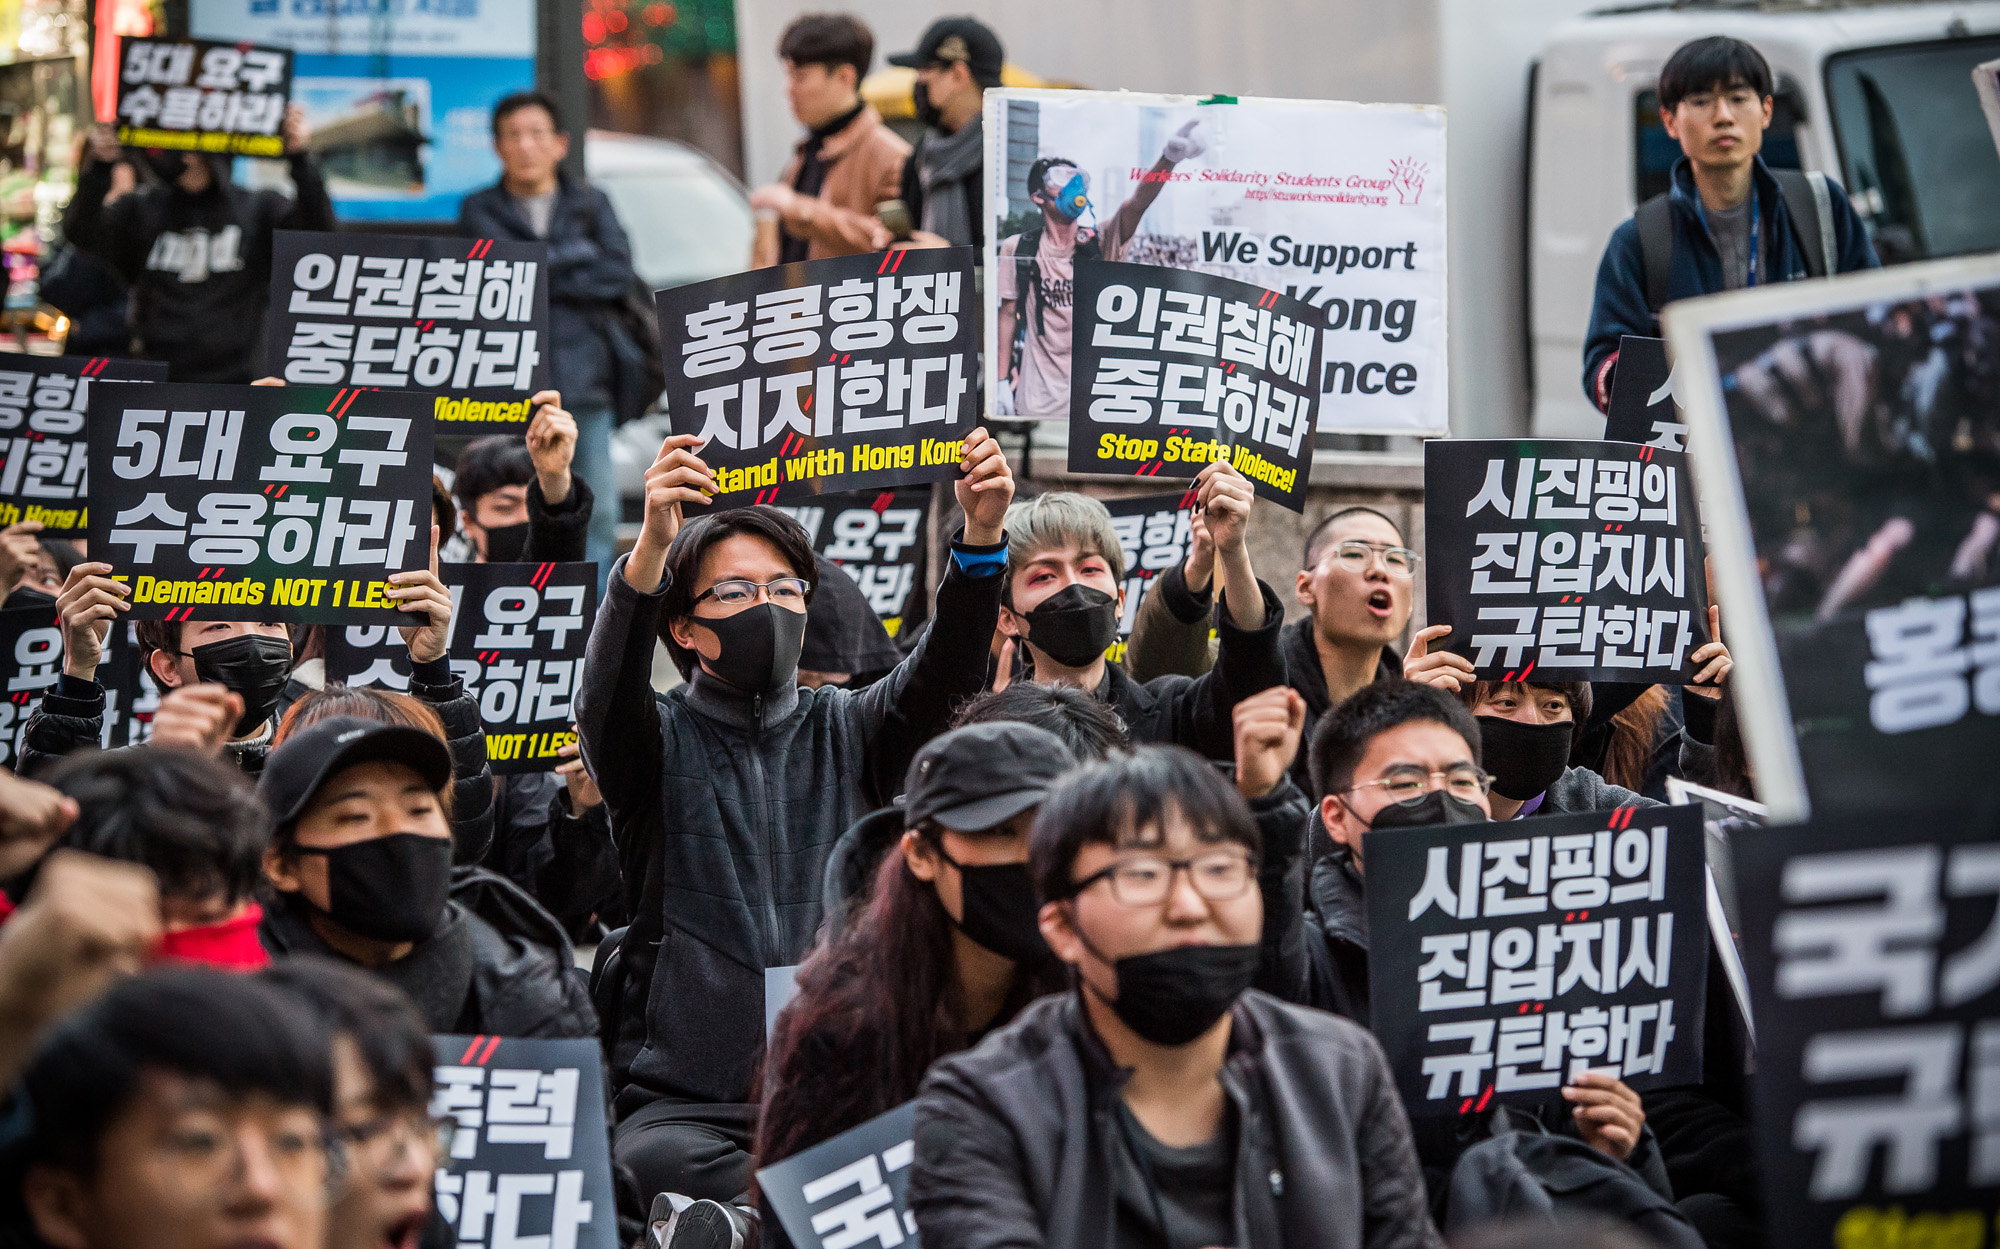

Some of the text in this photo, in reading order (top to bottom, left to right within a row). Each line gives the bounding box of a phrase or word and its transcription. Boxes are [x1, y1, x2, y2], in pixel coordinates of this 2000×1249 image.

[121, 41, 287, 93] 5대 요구
[118, 84, 286, 134] 수용하라
[1199, 168, 1268, 185] Solidarity
[1274, 171, 1341, 188] Students
[1346, 174, 1391, 191] Group
[1202, 231, 1417, 275] We Support
[288, 253, 538, 322] 인권침해
[284, 322, 540, 390] 중단하라
[682, 271, 961, 378] 홍콩항쟁
[1091, 284, 1315, 387] 인권침해
[0, 370, 88, 434] 콩항
[691, 353, 967, 456] 지지한다
[1088, 357, 1310, 459] 중단하라
[112, 409, 412, 486] 5대 요구
[785, 448, 845, 481] with
[852, 444, 915, 472] Hong
[920, 438, 966, 466] Kong
[1097, 433, 1297, 493] Stop State Violence!
[1466, 457, 1677, 526] 시진핑의
[109, 492, 417, 569] 수용하라
[823, 508, 922, 562] 요구
[1110, 509, 1193, 571] 콩항
[133, 575, 265, 605] Demands
[270, 578, 327, 607] NOT
[332, 579, 344, 607] 1
[348, 580, 414, 609] LES
[1470, 531, 1685, 598] 진압지시
[473, 585, 586, 649] 요구
[1470, 604, 1693, 671] 규탄한다
[8, 621, 114, 691] 요
[486, 732, 579, 759] NOT 1 LES
[1408, 826, 1668, 922] 시진핑의
[1417, 912, 1673, 1012] 진압지시
[1421, 999, 1676, 1100] 규탄한다
[1792, 1019, 2000, 1198] 규
